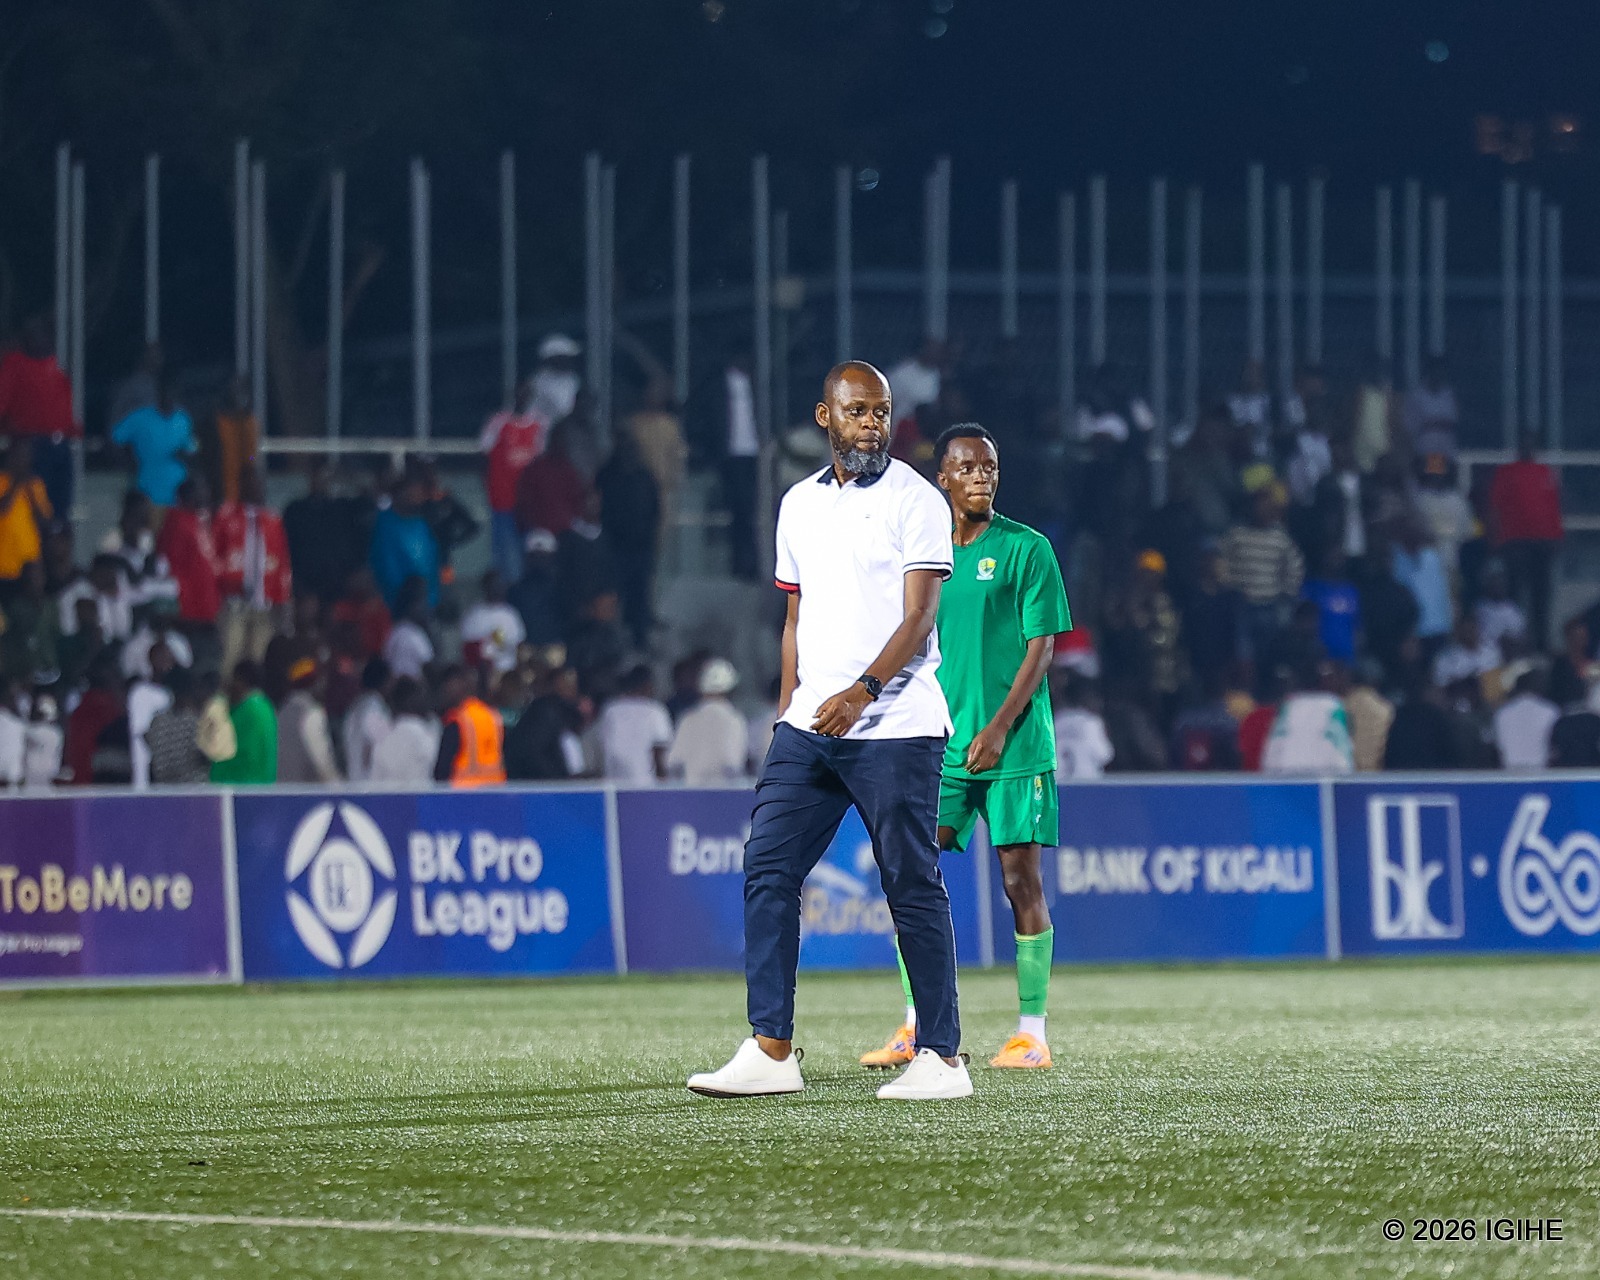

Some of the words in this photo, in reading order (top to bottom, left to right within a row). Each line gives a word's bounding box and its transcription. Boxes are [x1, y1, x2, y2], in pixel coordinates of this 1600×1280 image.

[408, 829, 466, 883] BK
[470, 829, 543, 883] Pro
[1058, 847, 1150, 894] BANK
[1151, 846, 1200, 894] OF
[1203, 846, 1313, 894] KIGALI
[411, 885, 569, 951] League
